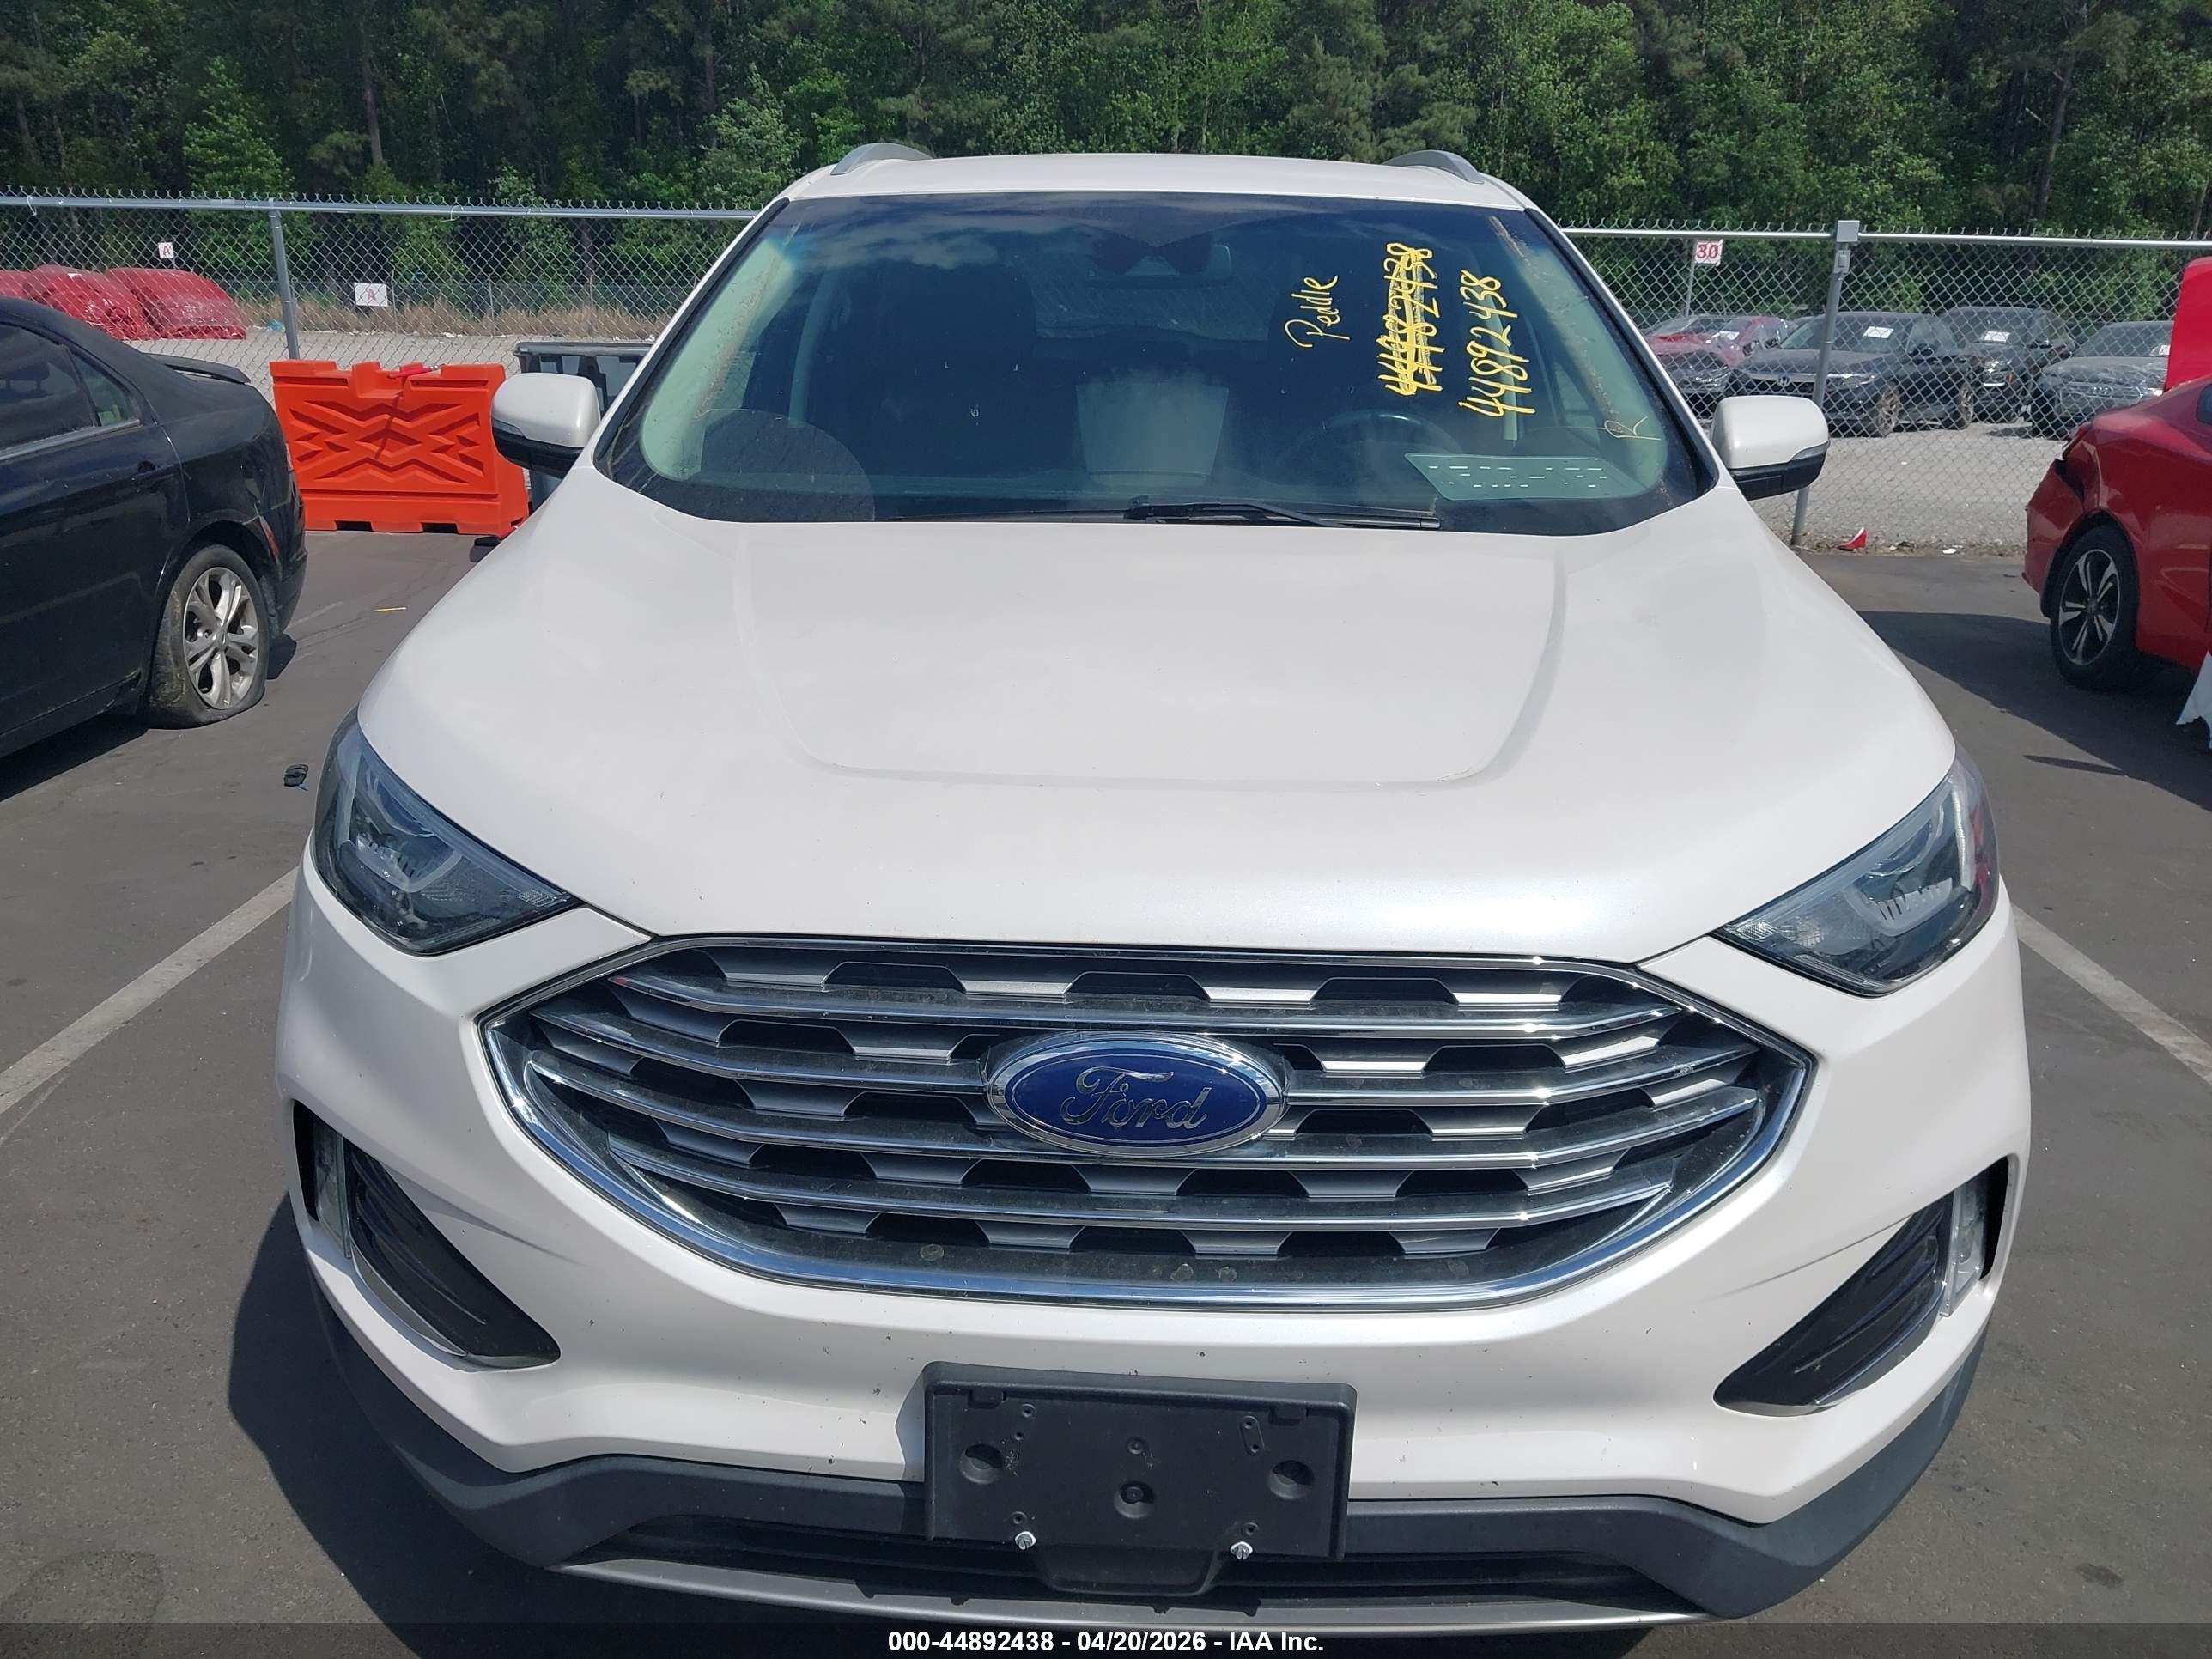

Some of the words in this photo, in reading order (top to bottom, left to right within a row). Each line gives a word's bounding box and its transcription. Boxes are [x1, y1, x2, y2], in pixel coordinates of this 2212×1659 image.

[1697, 244, 1718, 259] 30
[1458, 270, 1536, 417] 44892438
[1060, 1066, 1212, 1129] Ford
